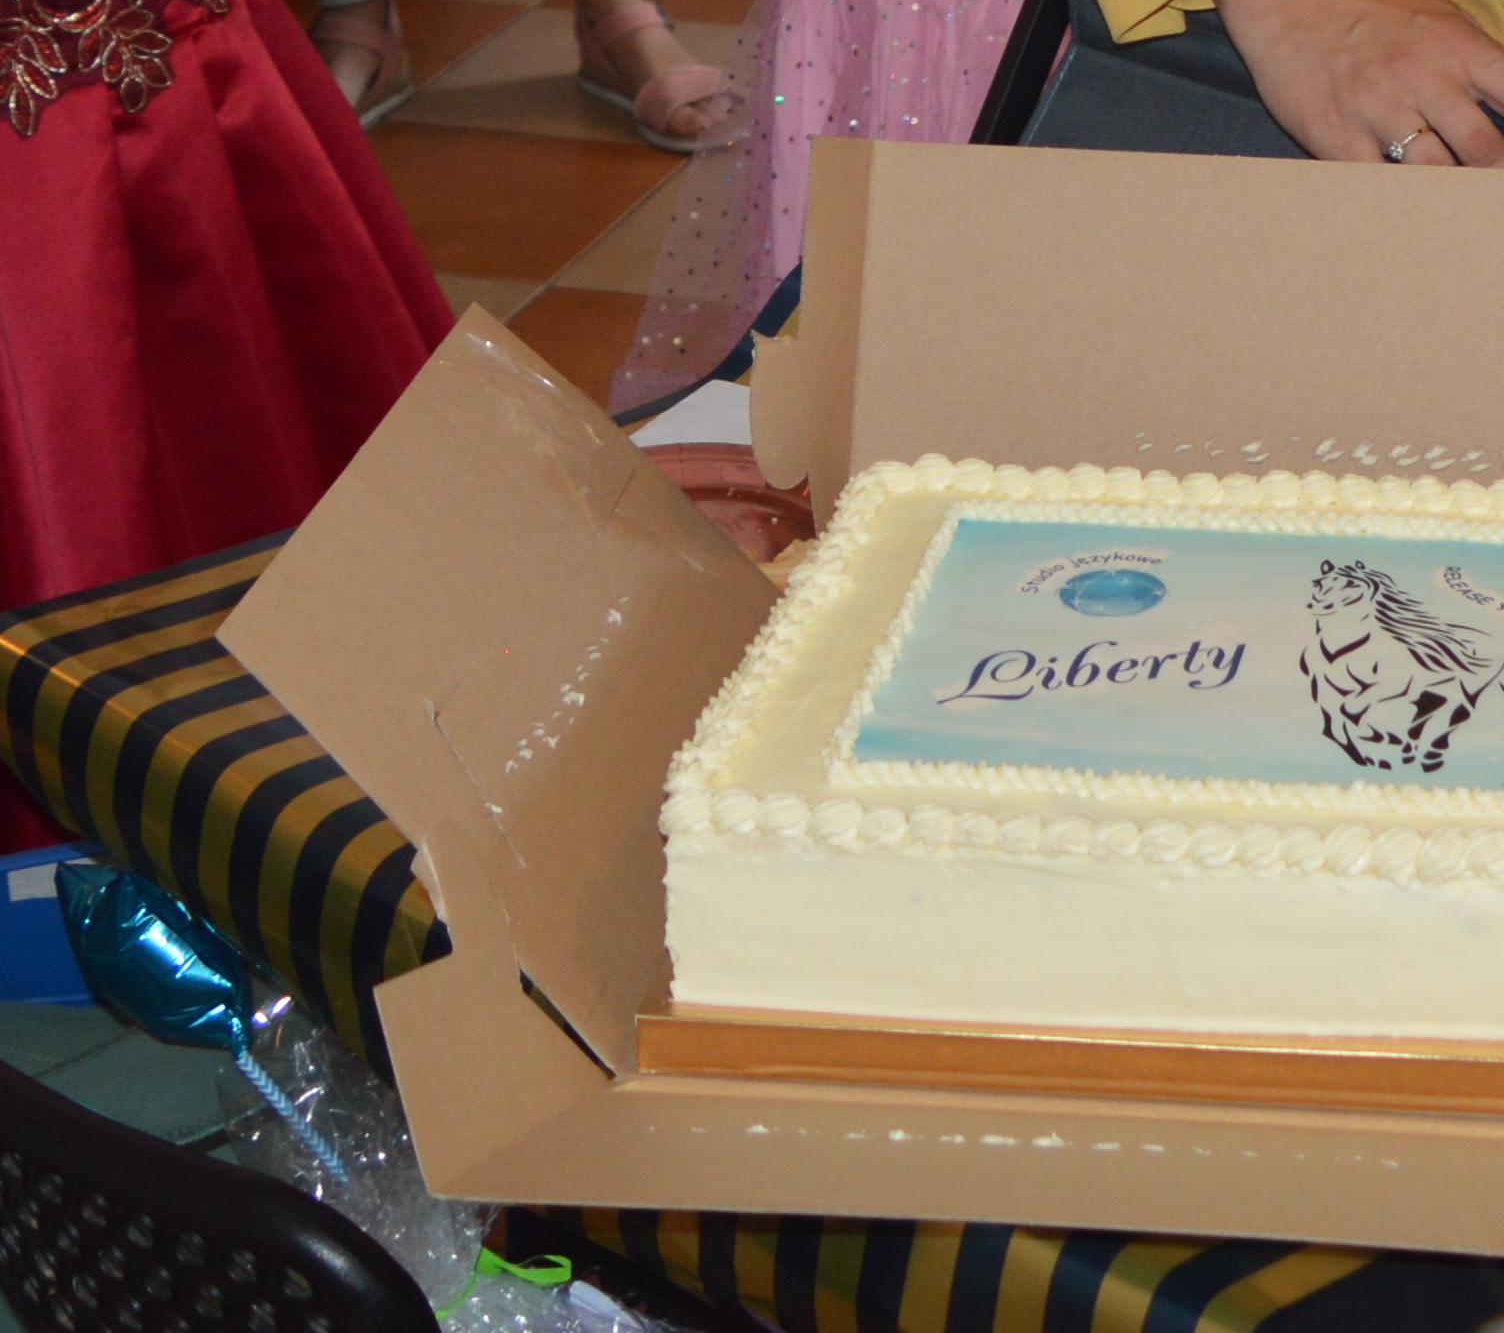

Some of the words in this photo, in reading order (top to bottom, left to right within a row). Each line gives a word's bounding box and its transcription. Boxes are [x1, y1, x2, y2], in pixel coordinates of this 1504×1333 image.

[1021, 563, 1065, 594] Studio
[1068, 541, 1162, 569] językowe
[1443, 566, 1494, 606] RELEASE
[937, 640, 1246, 705] Liberty
